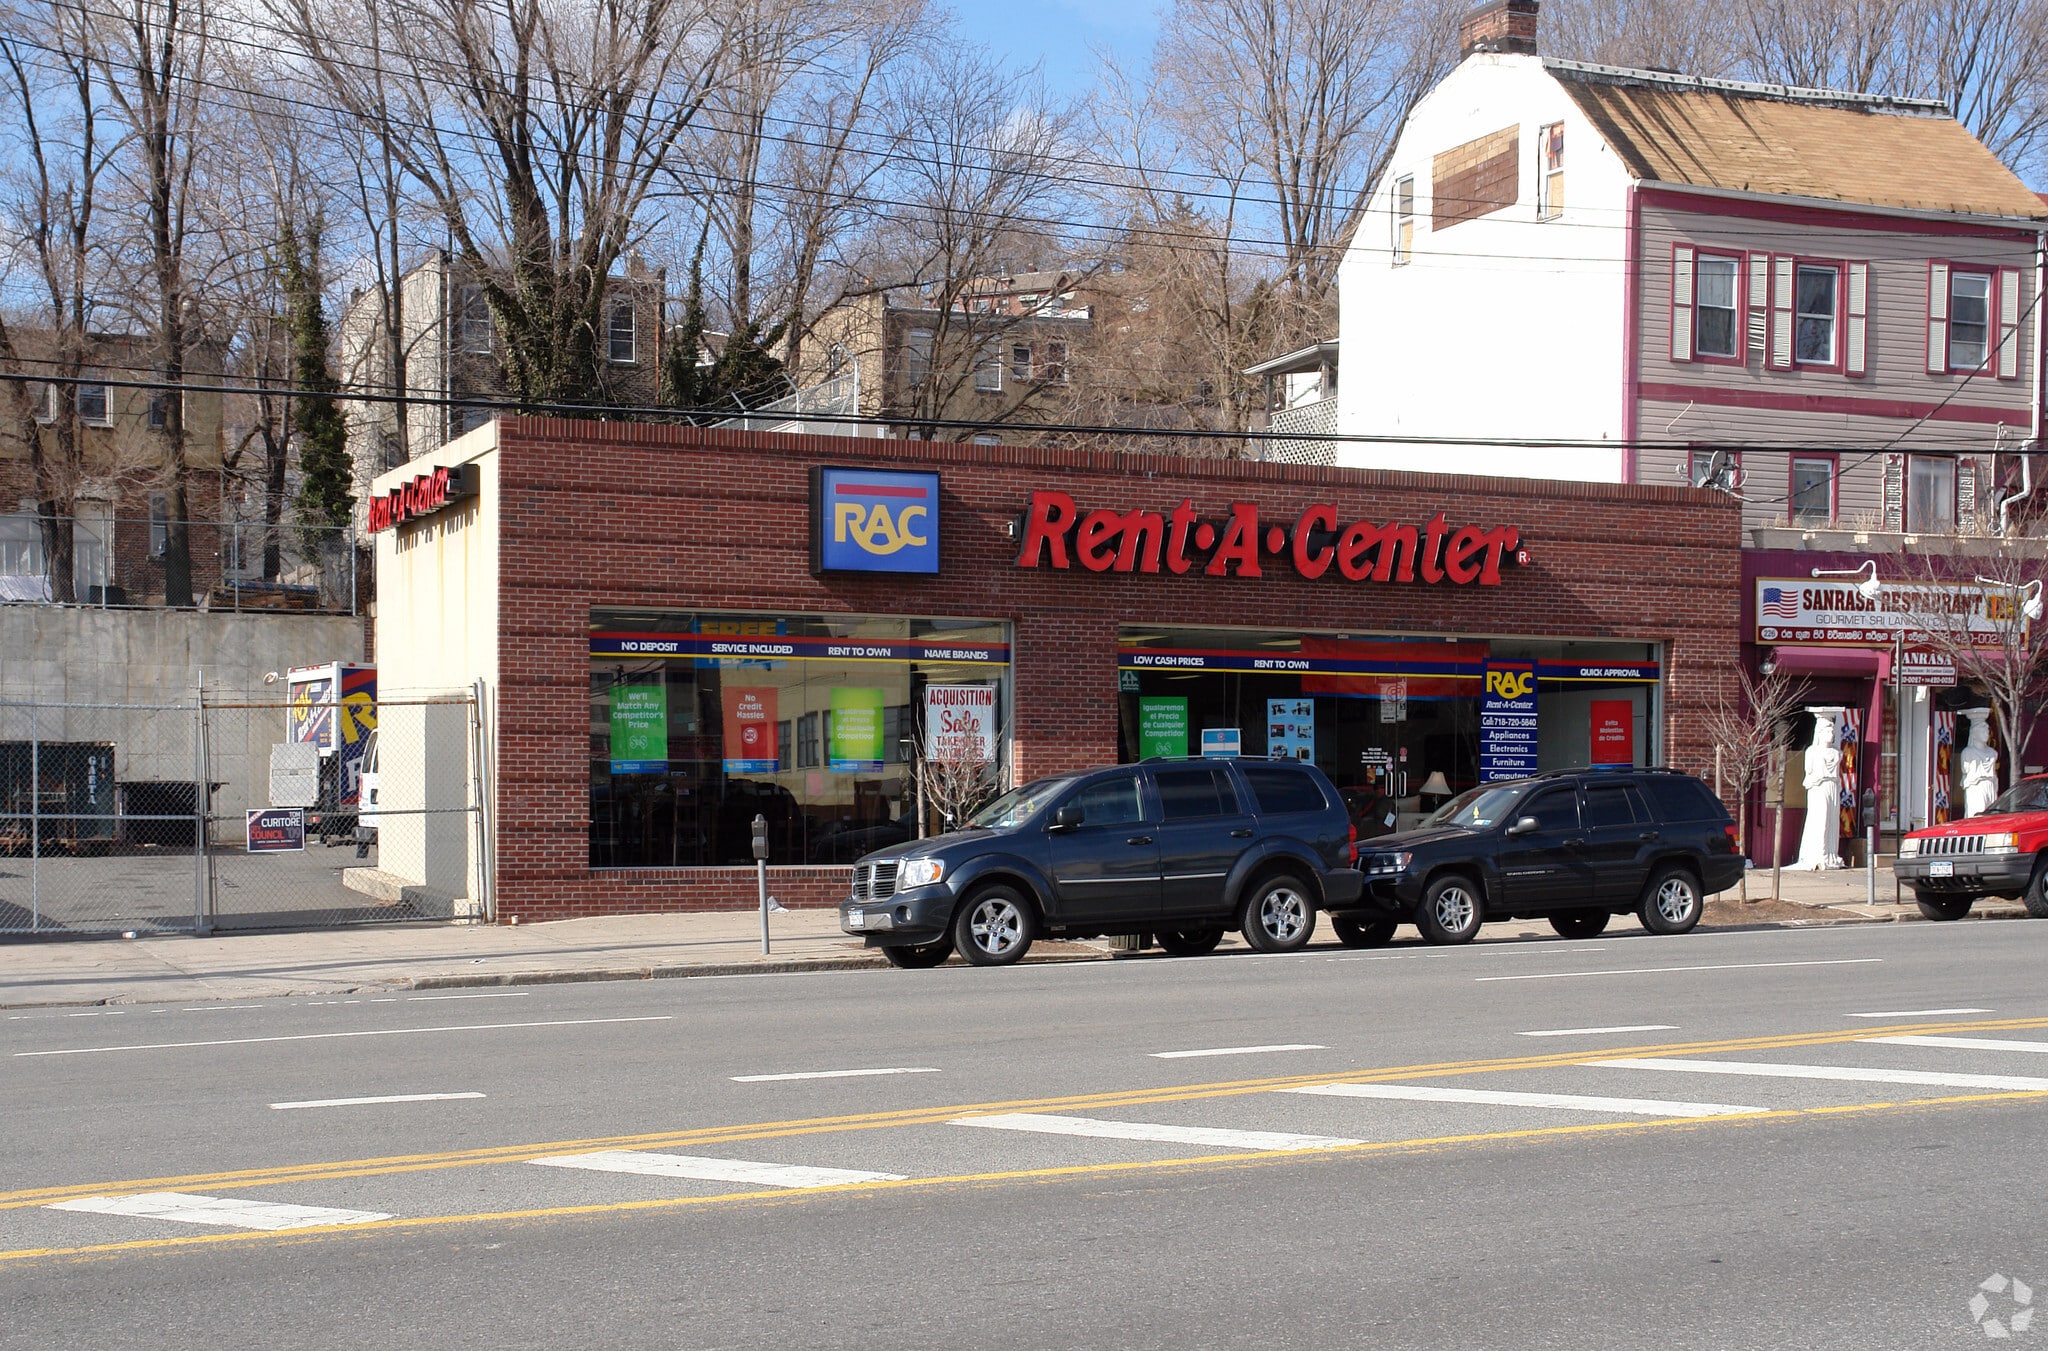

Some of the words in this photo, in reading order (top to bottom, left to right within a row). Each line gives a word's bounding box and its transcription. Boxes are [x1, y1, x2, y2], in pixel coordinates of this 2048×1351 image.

[834, 502, 927, 555] RAC
[1803, 588, 1876, 612] SANRASA
[1879, 590, 1983, 615] RESTAURANT
[1816, 614, 1866, 625] GOURMET
[1869, 616, 1886, 626] SRI
[621, 642, 638, 651] NO
[640, 643, 678, 652] DEPOSIT
[711, 643, 747, 653] SERVICE
[749, 644, 794, 654] INCLUDED
[828, 647, 851, 656] RENT
[852, 647, 864, 657] TO
[866, 648, 891, 657] OWN
[924, 649, 951, 659] NAME
[953, 651, 988, 660] BRANDS
[1133, 655, 1153, 665] LOW
[1155, 656, 1177, 666] CASH
[1178, 657, 1204, 666] PRICES
[1254, 659, 1274, 669] RENT
[1275, 660, 1286, 669] TO
[1287, 660, 1309, 669] OWN
[1580, 668, 1603, 677] QUICK
[1604, 668, 1640, 677] APPROVAL
[1486, 671, 1533, 699] RAC
[628, 692, 648, 700] We'll
[745, 694, 756, 702] No
[930, 689, 992, 708] ACQUISITION
[617, 702, 642, 710] Match
[643, 702, 660, 710] Any
[738, 703, 762, 711] Credit
[612, 711, 664, 720] Competitor's
[736, 711, 765, 720] Hassles
[1150, 712, 1157, 720] el
[628, 720, 649, 729] Price
[941, 709, 981, 734] Sale
[1153, 721, 1185, 729] Cualquier
[1144, 730, 1185, 738] Competidor
[1489, 730, 1530, 741] Appliances
[1490, 744, 1528, 753] Electronics
[1492, 757, 1525, 767] Furniture
[261, 817, 301, 828] CURITORE
[250, 830, 285, 840] COUNCIL
